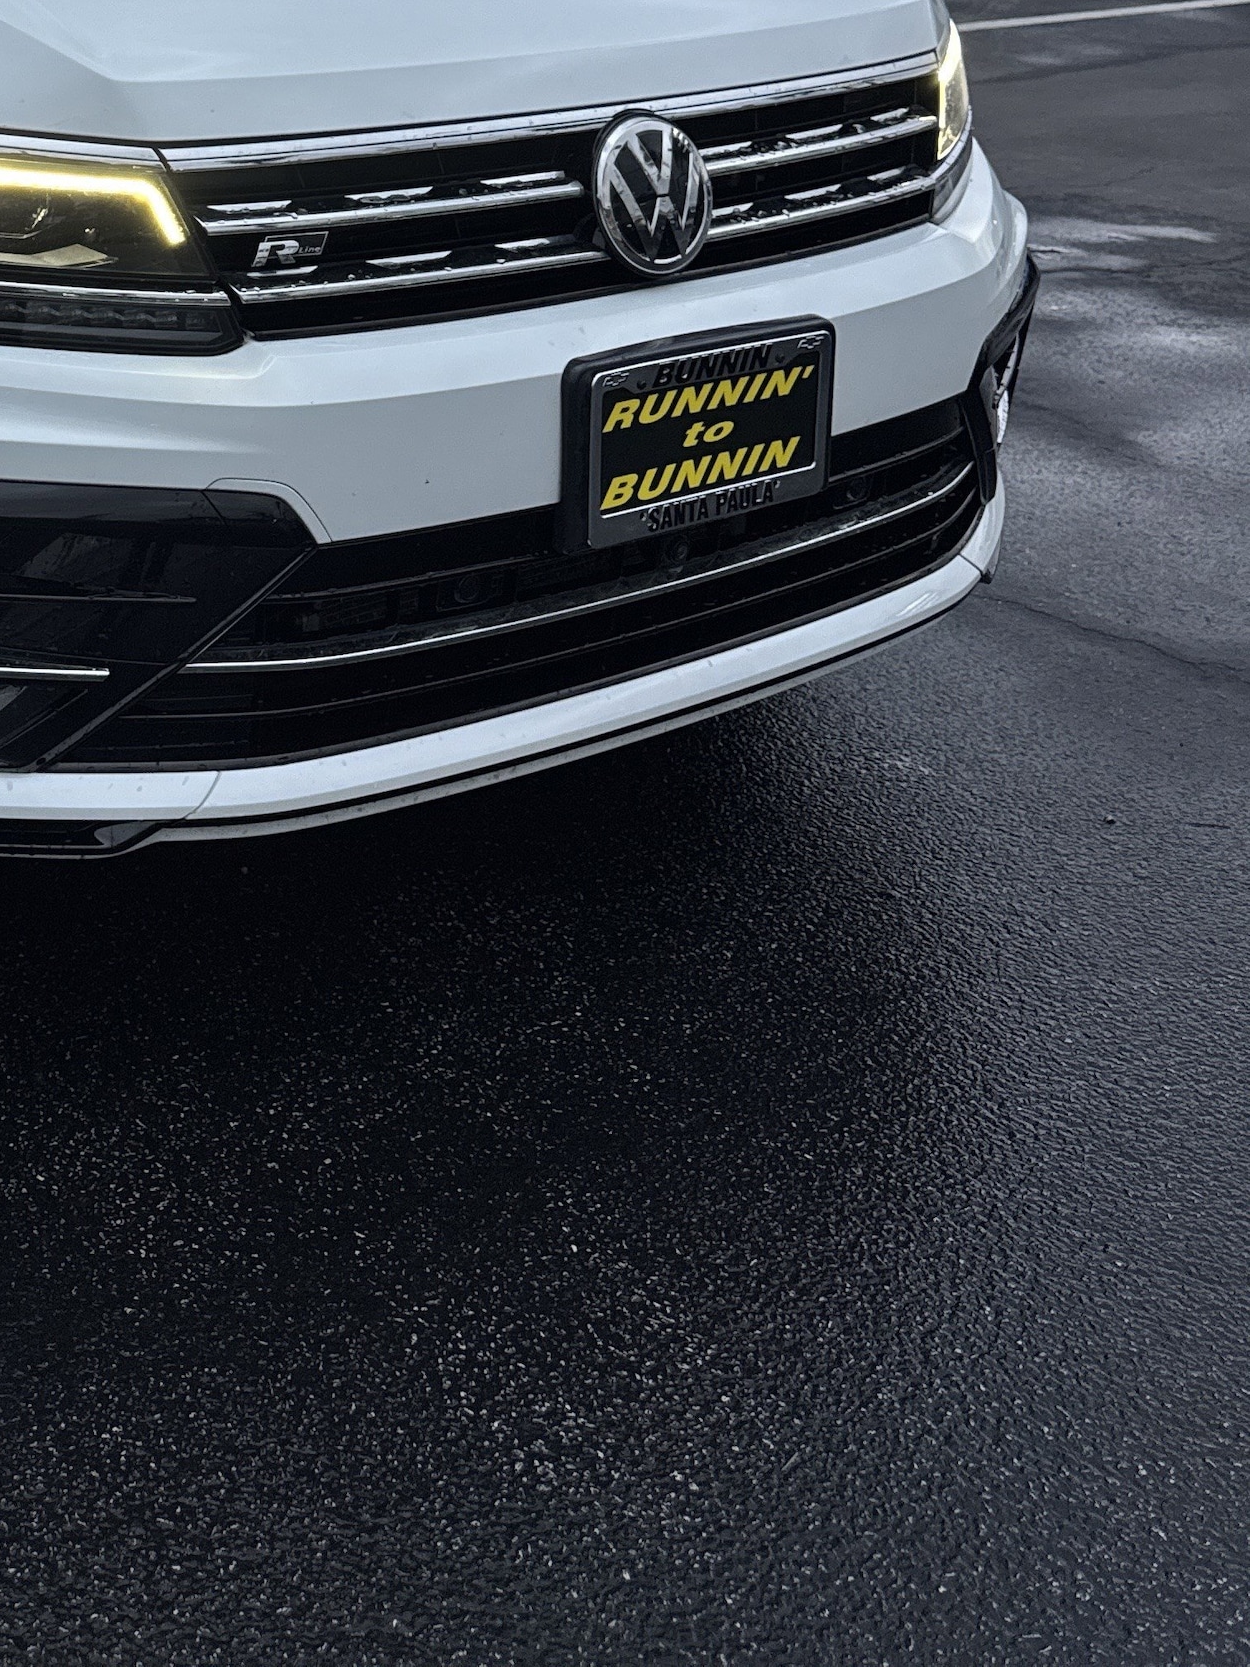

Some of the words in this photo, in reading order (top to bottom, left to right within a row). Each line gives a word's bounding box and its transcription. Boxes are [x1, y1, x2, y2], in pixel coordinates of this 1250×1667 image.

[652, 343, 773, 388] BUNNIN
[602, 364, 815, 433] RUNNIN'
[682, 420, 735, 448] to
[600, 435, 801, 510] BUNNIN
